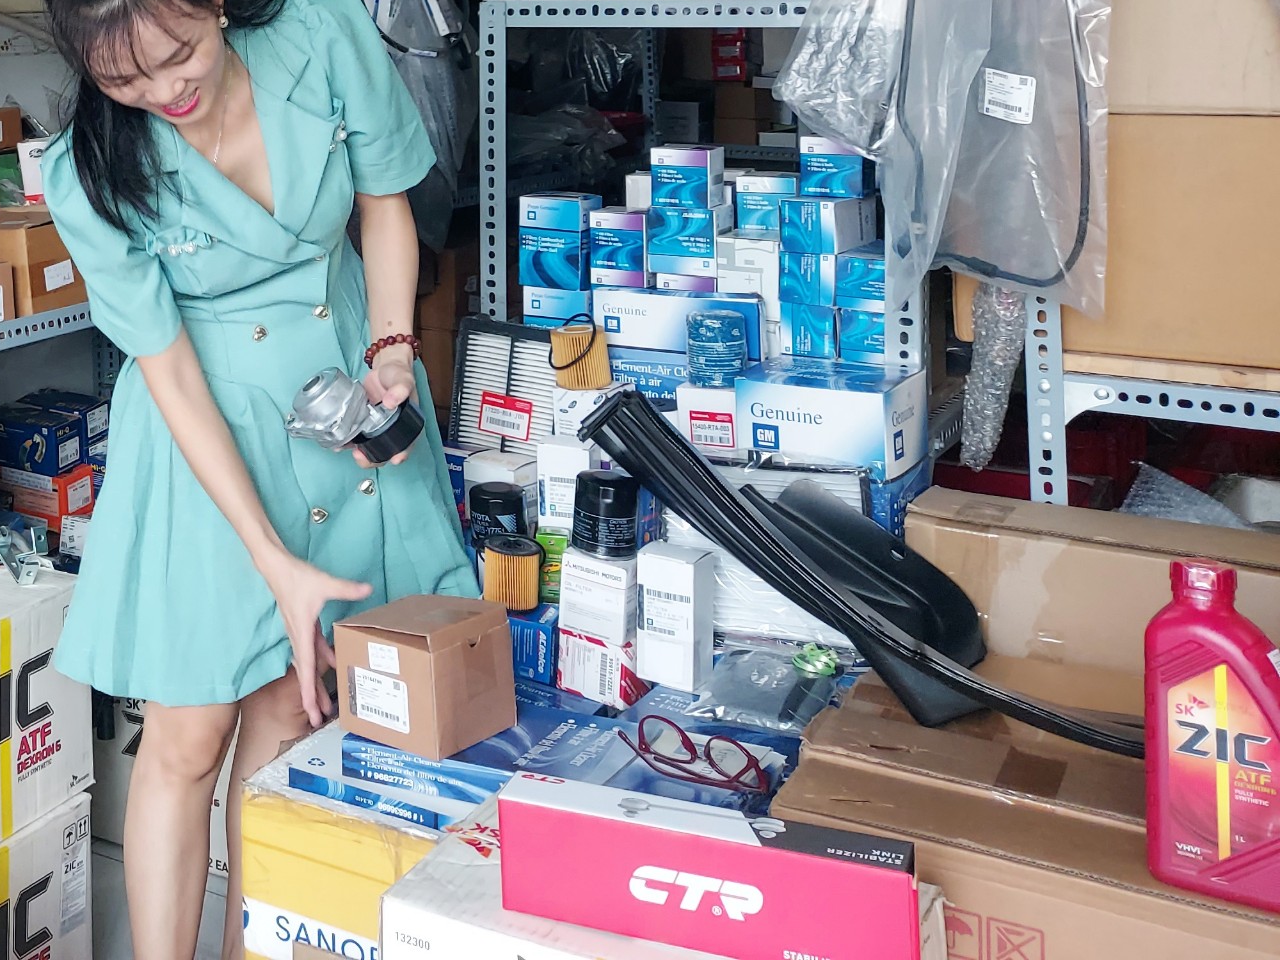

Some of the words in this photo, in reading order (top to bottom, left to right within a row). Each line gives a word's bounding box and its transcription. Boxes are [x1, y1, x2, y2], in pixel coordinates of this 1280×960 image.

[602, 303, 647, 317] Genuine
[613, 373, 638, 385] Filtre
[647, 378, 663, 388] air
[750, 401, 824, 427] Genuine
[756, 429, 777, 445] GM
[572, 563, 600, 577] MITSUBISHI
[601, 572, 622, 583] MOTORS
[537, 629, 548, 674] ACDelco
[125, 697, 140, 711] SK
[1175, 702, 1195, 717] SK
[18, 721, 53, 755] ATF
[1174, 719, 1272, 773] ZIC
[367, 761, 403, 775] Elemento
[412, 755, 443, 768] Cleaner
[521, 773, 566, 785] CTR
[1234, 770, 1272, 786] ATF
[1234, 788, 1254, 798] FULLY
[1234, 794, 1270, 807] SYNTHETIC
[826, 846, 903, 866] STABILIZER
[871, 847, 905, 860] LINK
[628, 864, 765, 923] CTR
[394, 930, 431, 951] 132300
